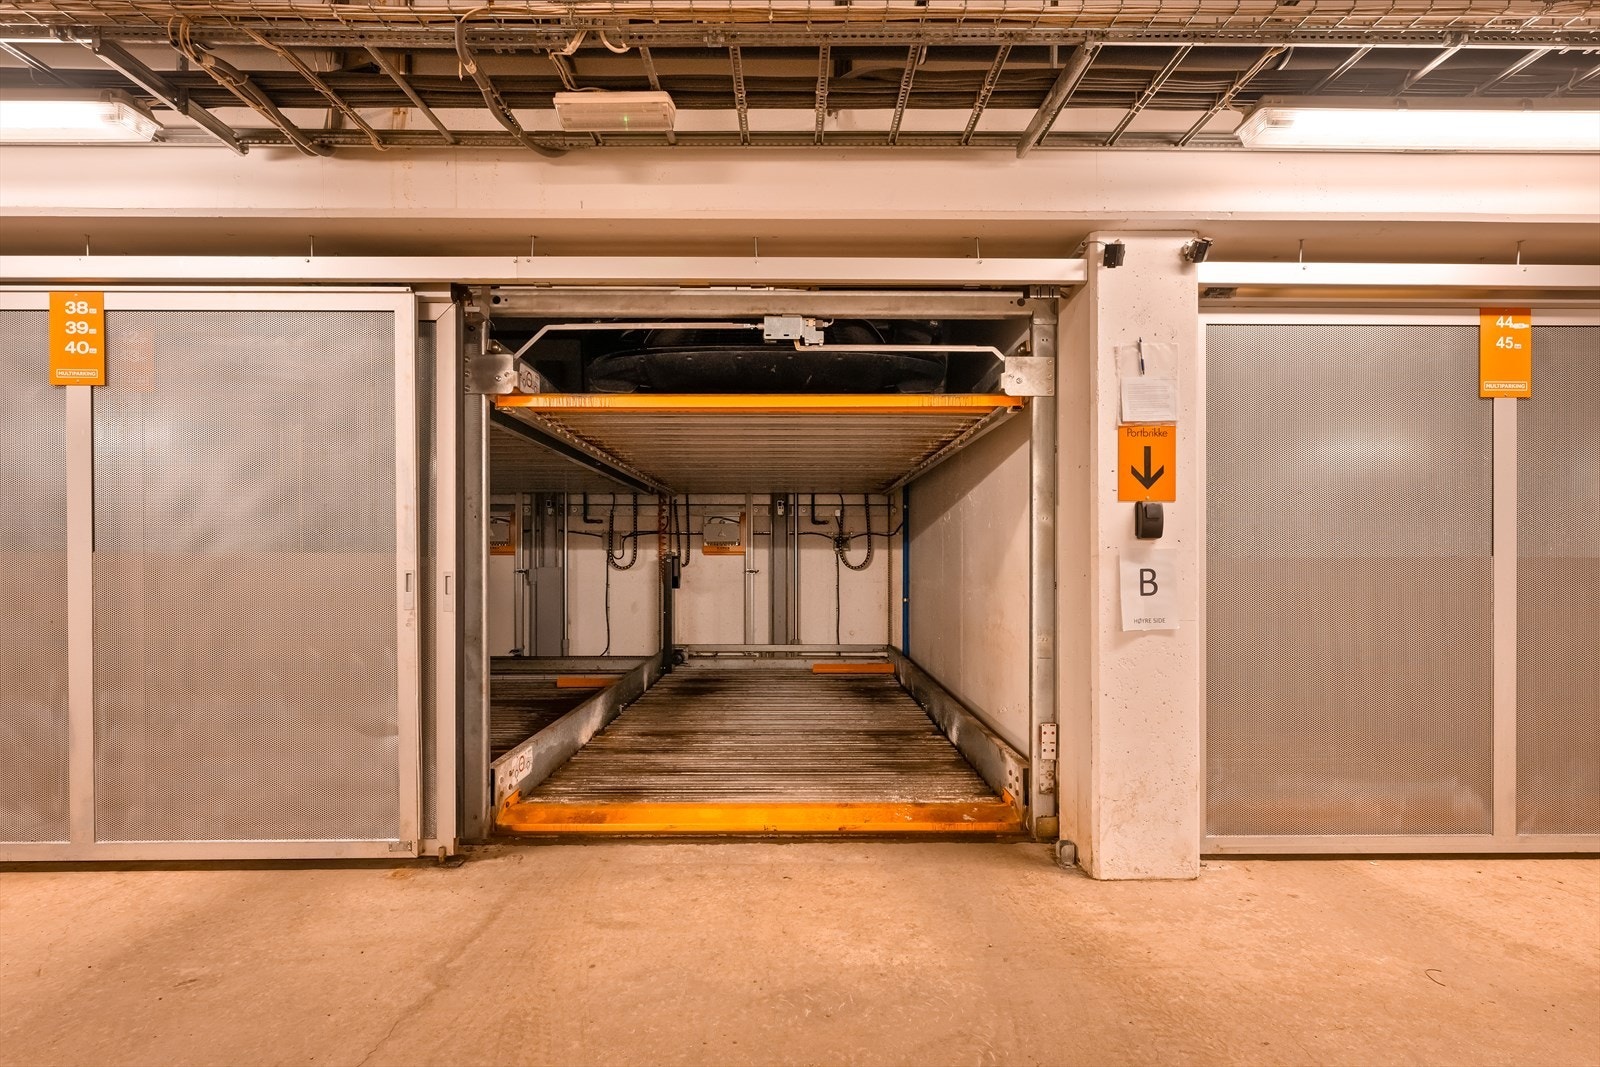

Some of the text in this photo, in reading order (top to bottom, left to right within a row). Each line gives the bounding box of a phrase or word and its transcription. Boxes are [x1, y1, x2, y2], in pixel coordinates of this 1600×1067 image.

[65, 301, 88, 314] 38
[65, 321, 89, 334] 39
[1496, 316, 1513, 328] 44
[64, 341, 89, 354] 40
[1496, 337, 1513, 349] 45
[1126, 428, 1168, 437] Portbrikke
[1139, 568, 1158, 596] B
